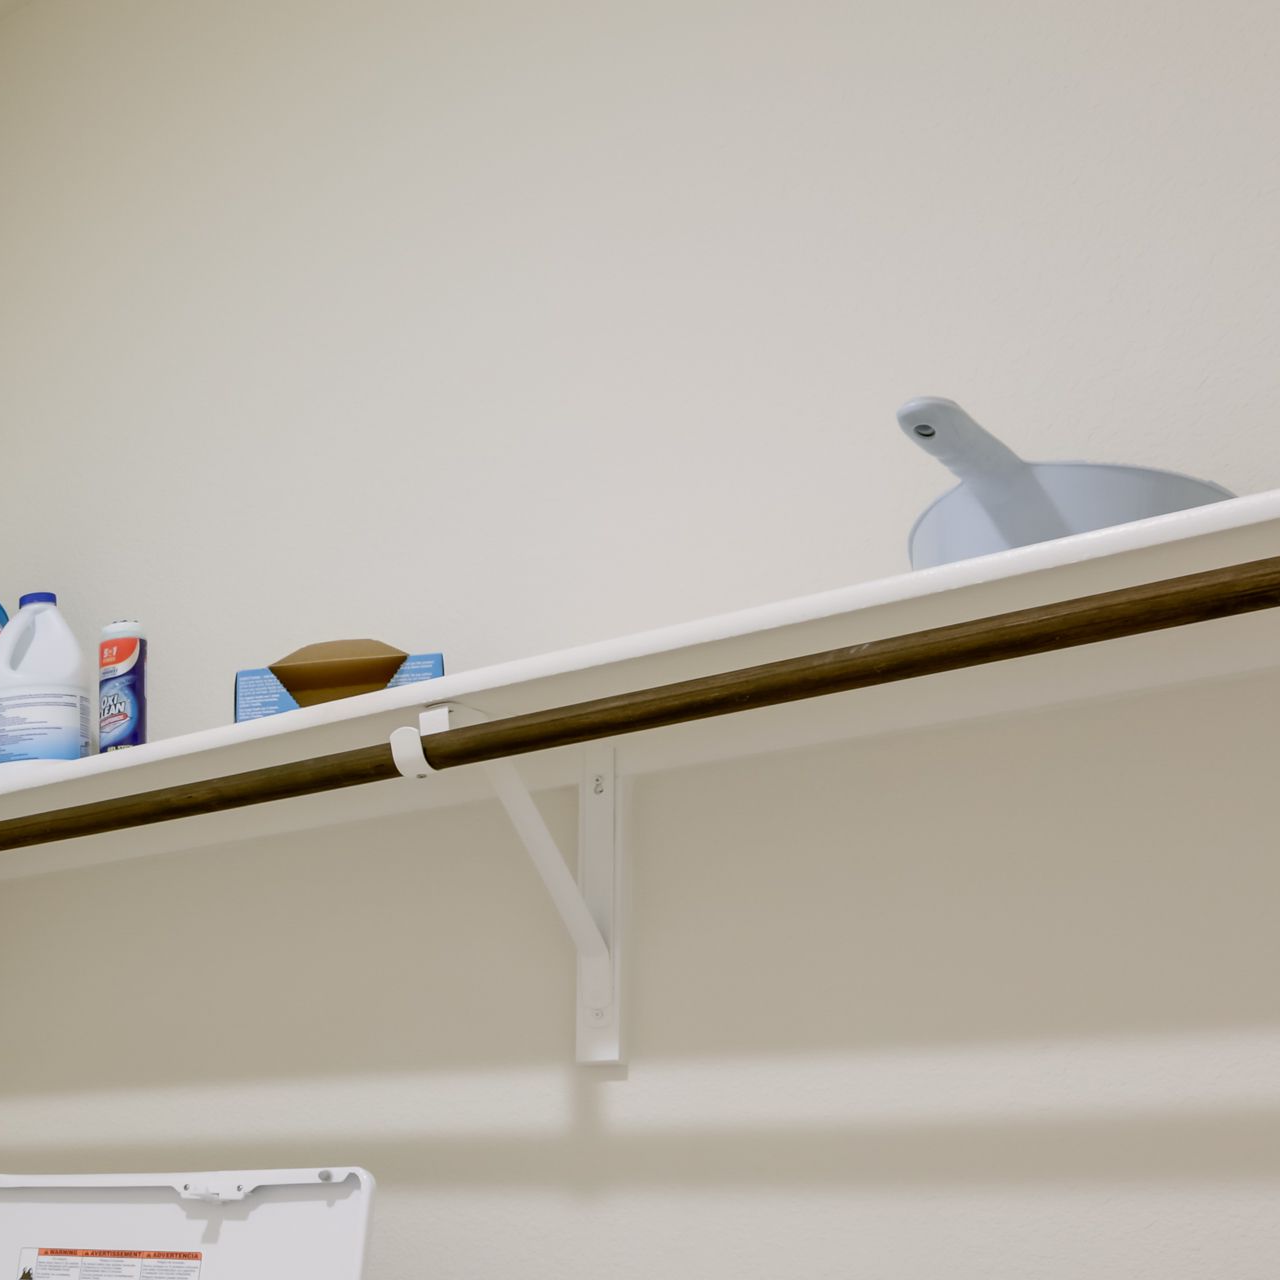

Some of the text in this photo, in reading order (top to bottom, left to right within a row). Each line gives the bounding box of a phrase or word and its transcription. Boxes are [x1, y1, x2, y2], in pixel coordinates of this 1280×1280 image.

[101, 694, 119, 709] OXI
[100, 701, 126, 719] LEAN
[90, 1250, 142, 1258] AVERTISSEMENT
